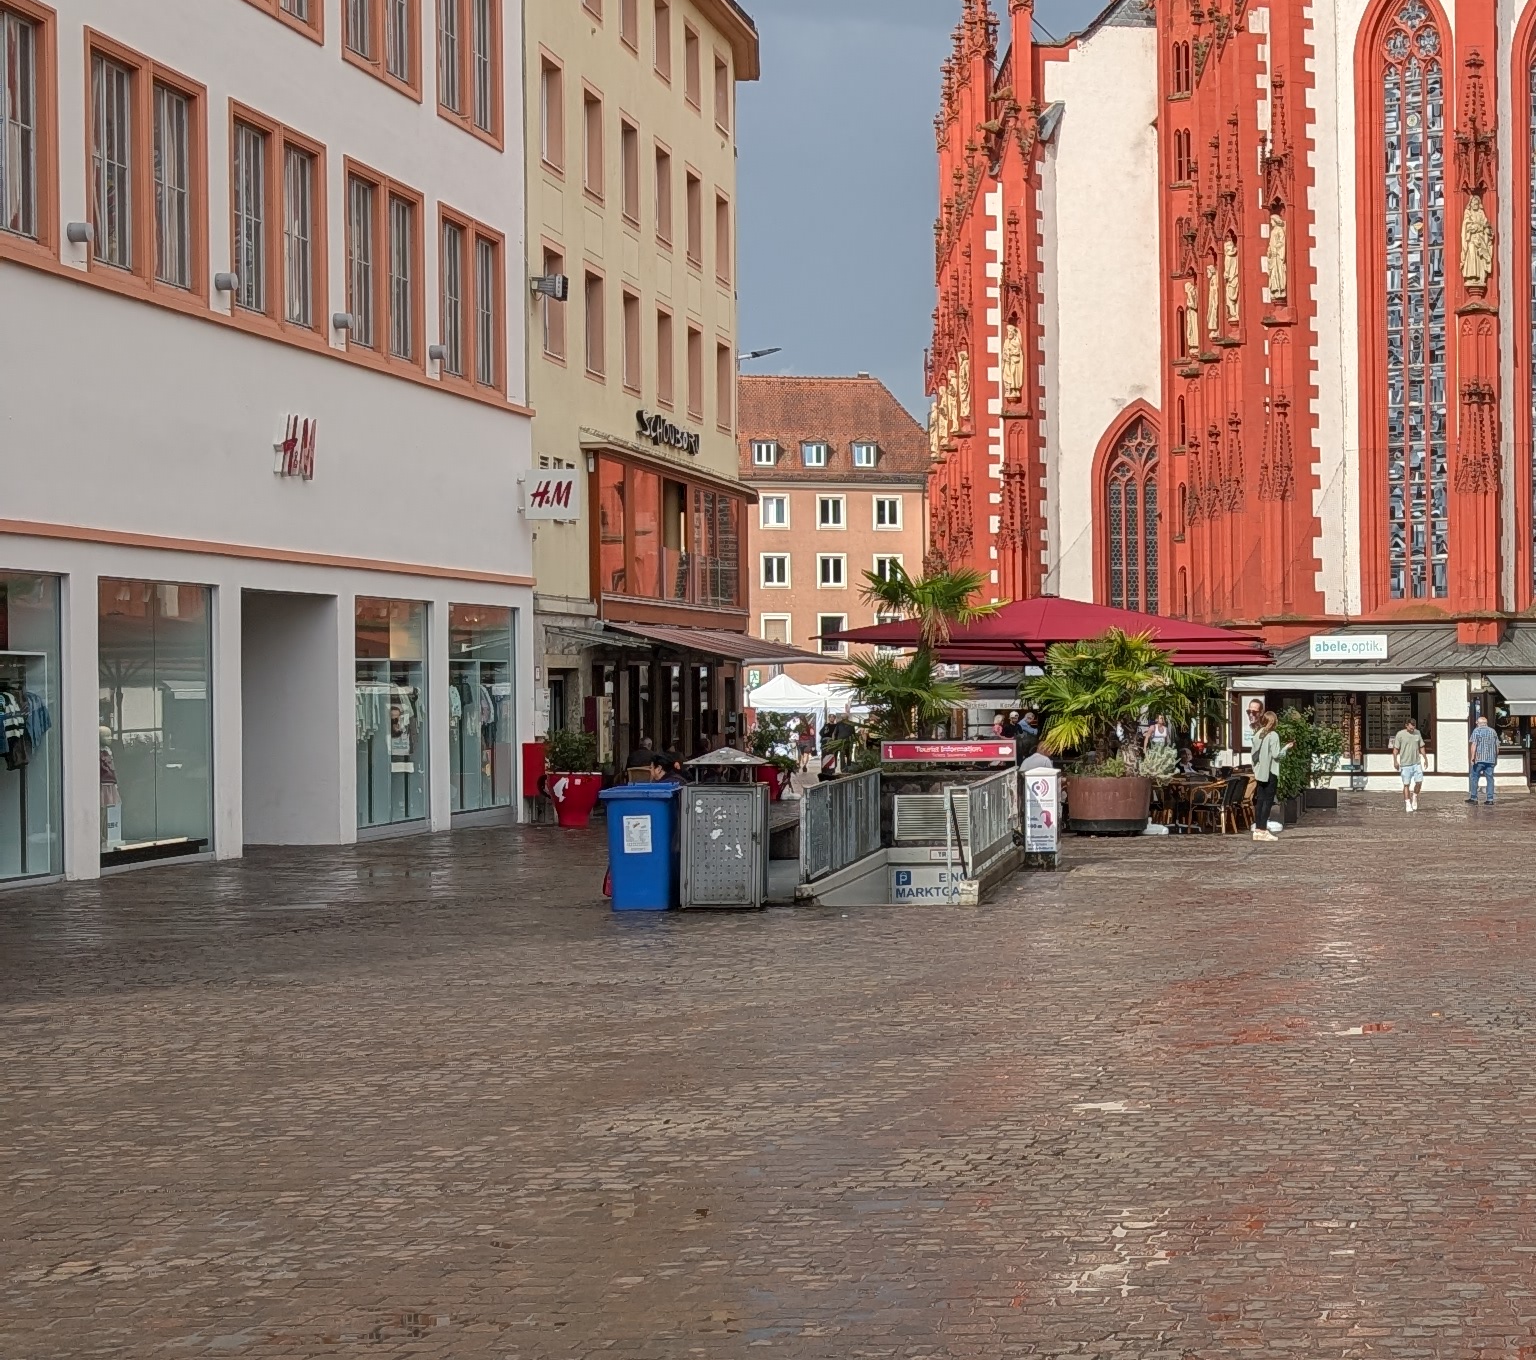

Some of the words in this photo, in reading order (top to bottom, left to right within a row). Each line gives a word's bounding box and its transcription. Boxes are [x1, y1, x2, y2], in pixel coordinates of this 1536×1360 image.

[277, 414, 317, 480] H&M
[530, 480, 573, 509] H&M
[895, 887, 960, 898] MARKTGA
